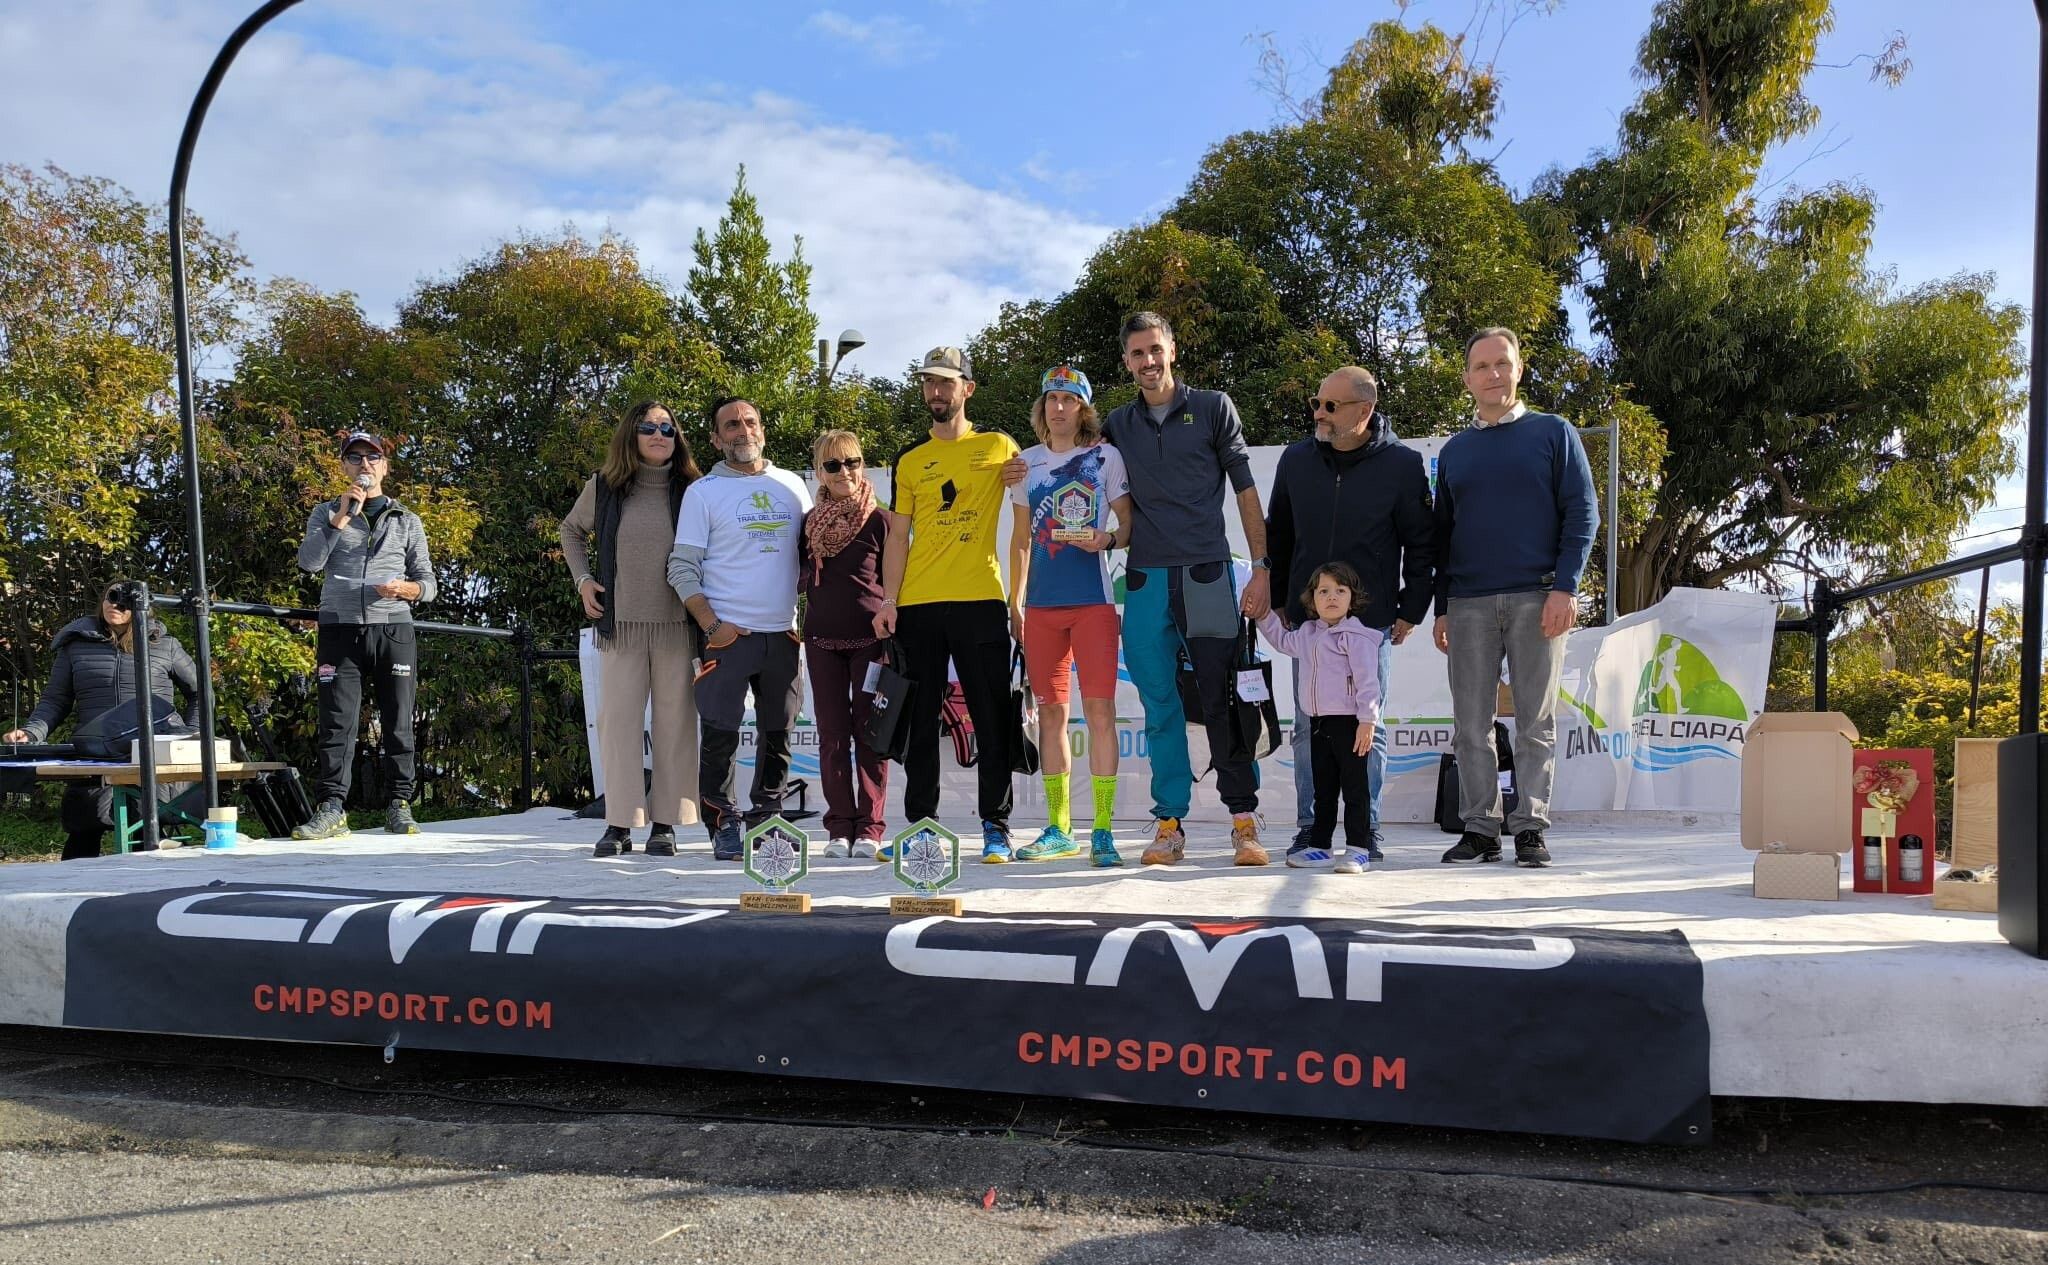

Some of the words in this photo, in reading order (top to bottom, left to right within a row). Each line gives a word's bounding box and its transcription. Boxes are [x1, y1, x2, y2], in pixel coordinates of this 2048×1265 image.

[157, 890, 728, 965] CMP
[885, 917, 1576, 1012] CMP
[254, 984, 552, 1029] CMPSPORT.COM
[1017, 1031, 1407, 1091] CMPSPORT.COM
